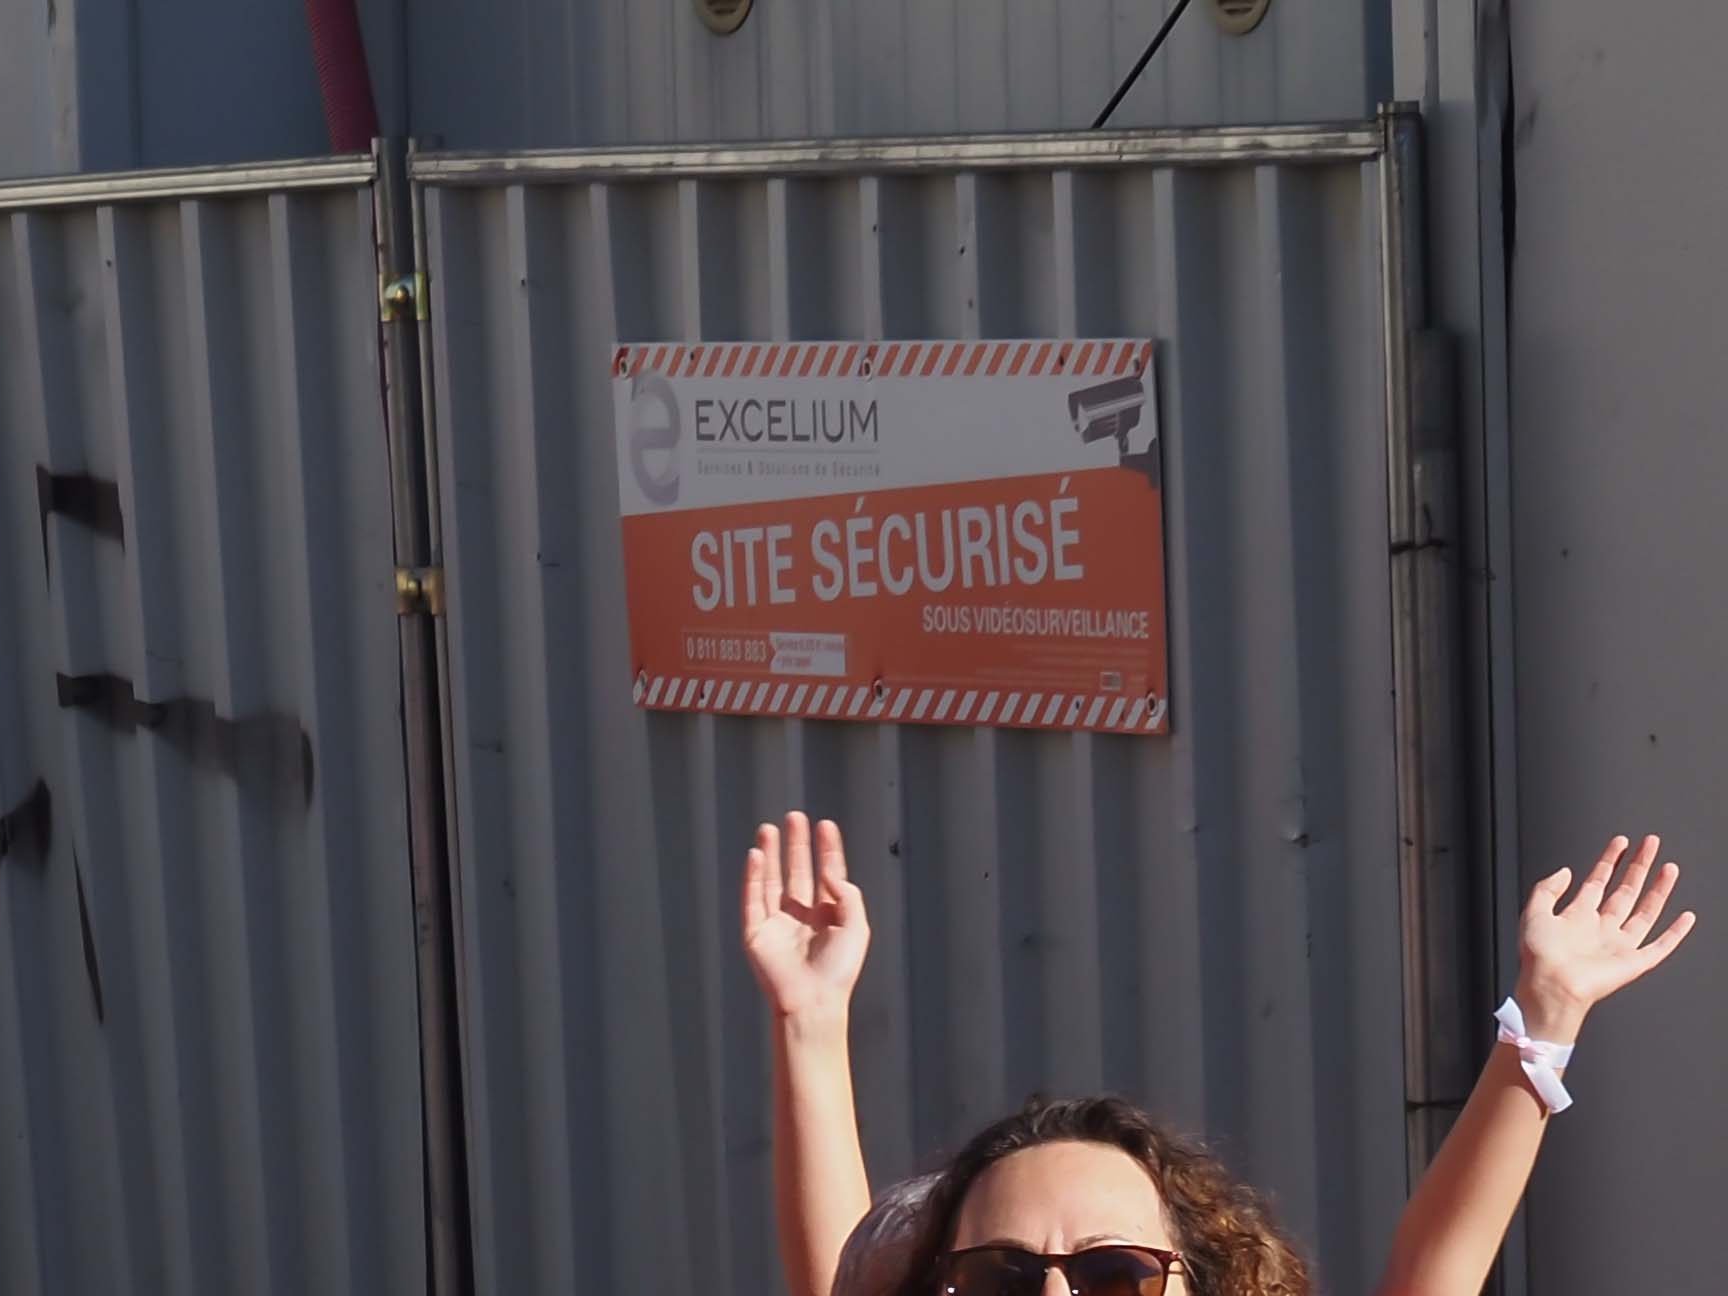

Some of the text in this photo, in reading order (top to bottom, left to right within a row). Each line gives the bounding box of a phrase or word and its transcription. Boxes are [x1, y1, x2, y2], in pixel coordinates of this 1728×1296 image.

[695, 398, 879, 442] EXCELIUM
[690, 478, 1084, 611] SITE SÉCURISÉ
[922, 600, 1150, 640] SOUS VIDÉOSURVEILLANCE
